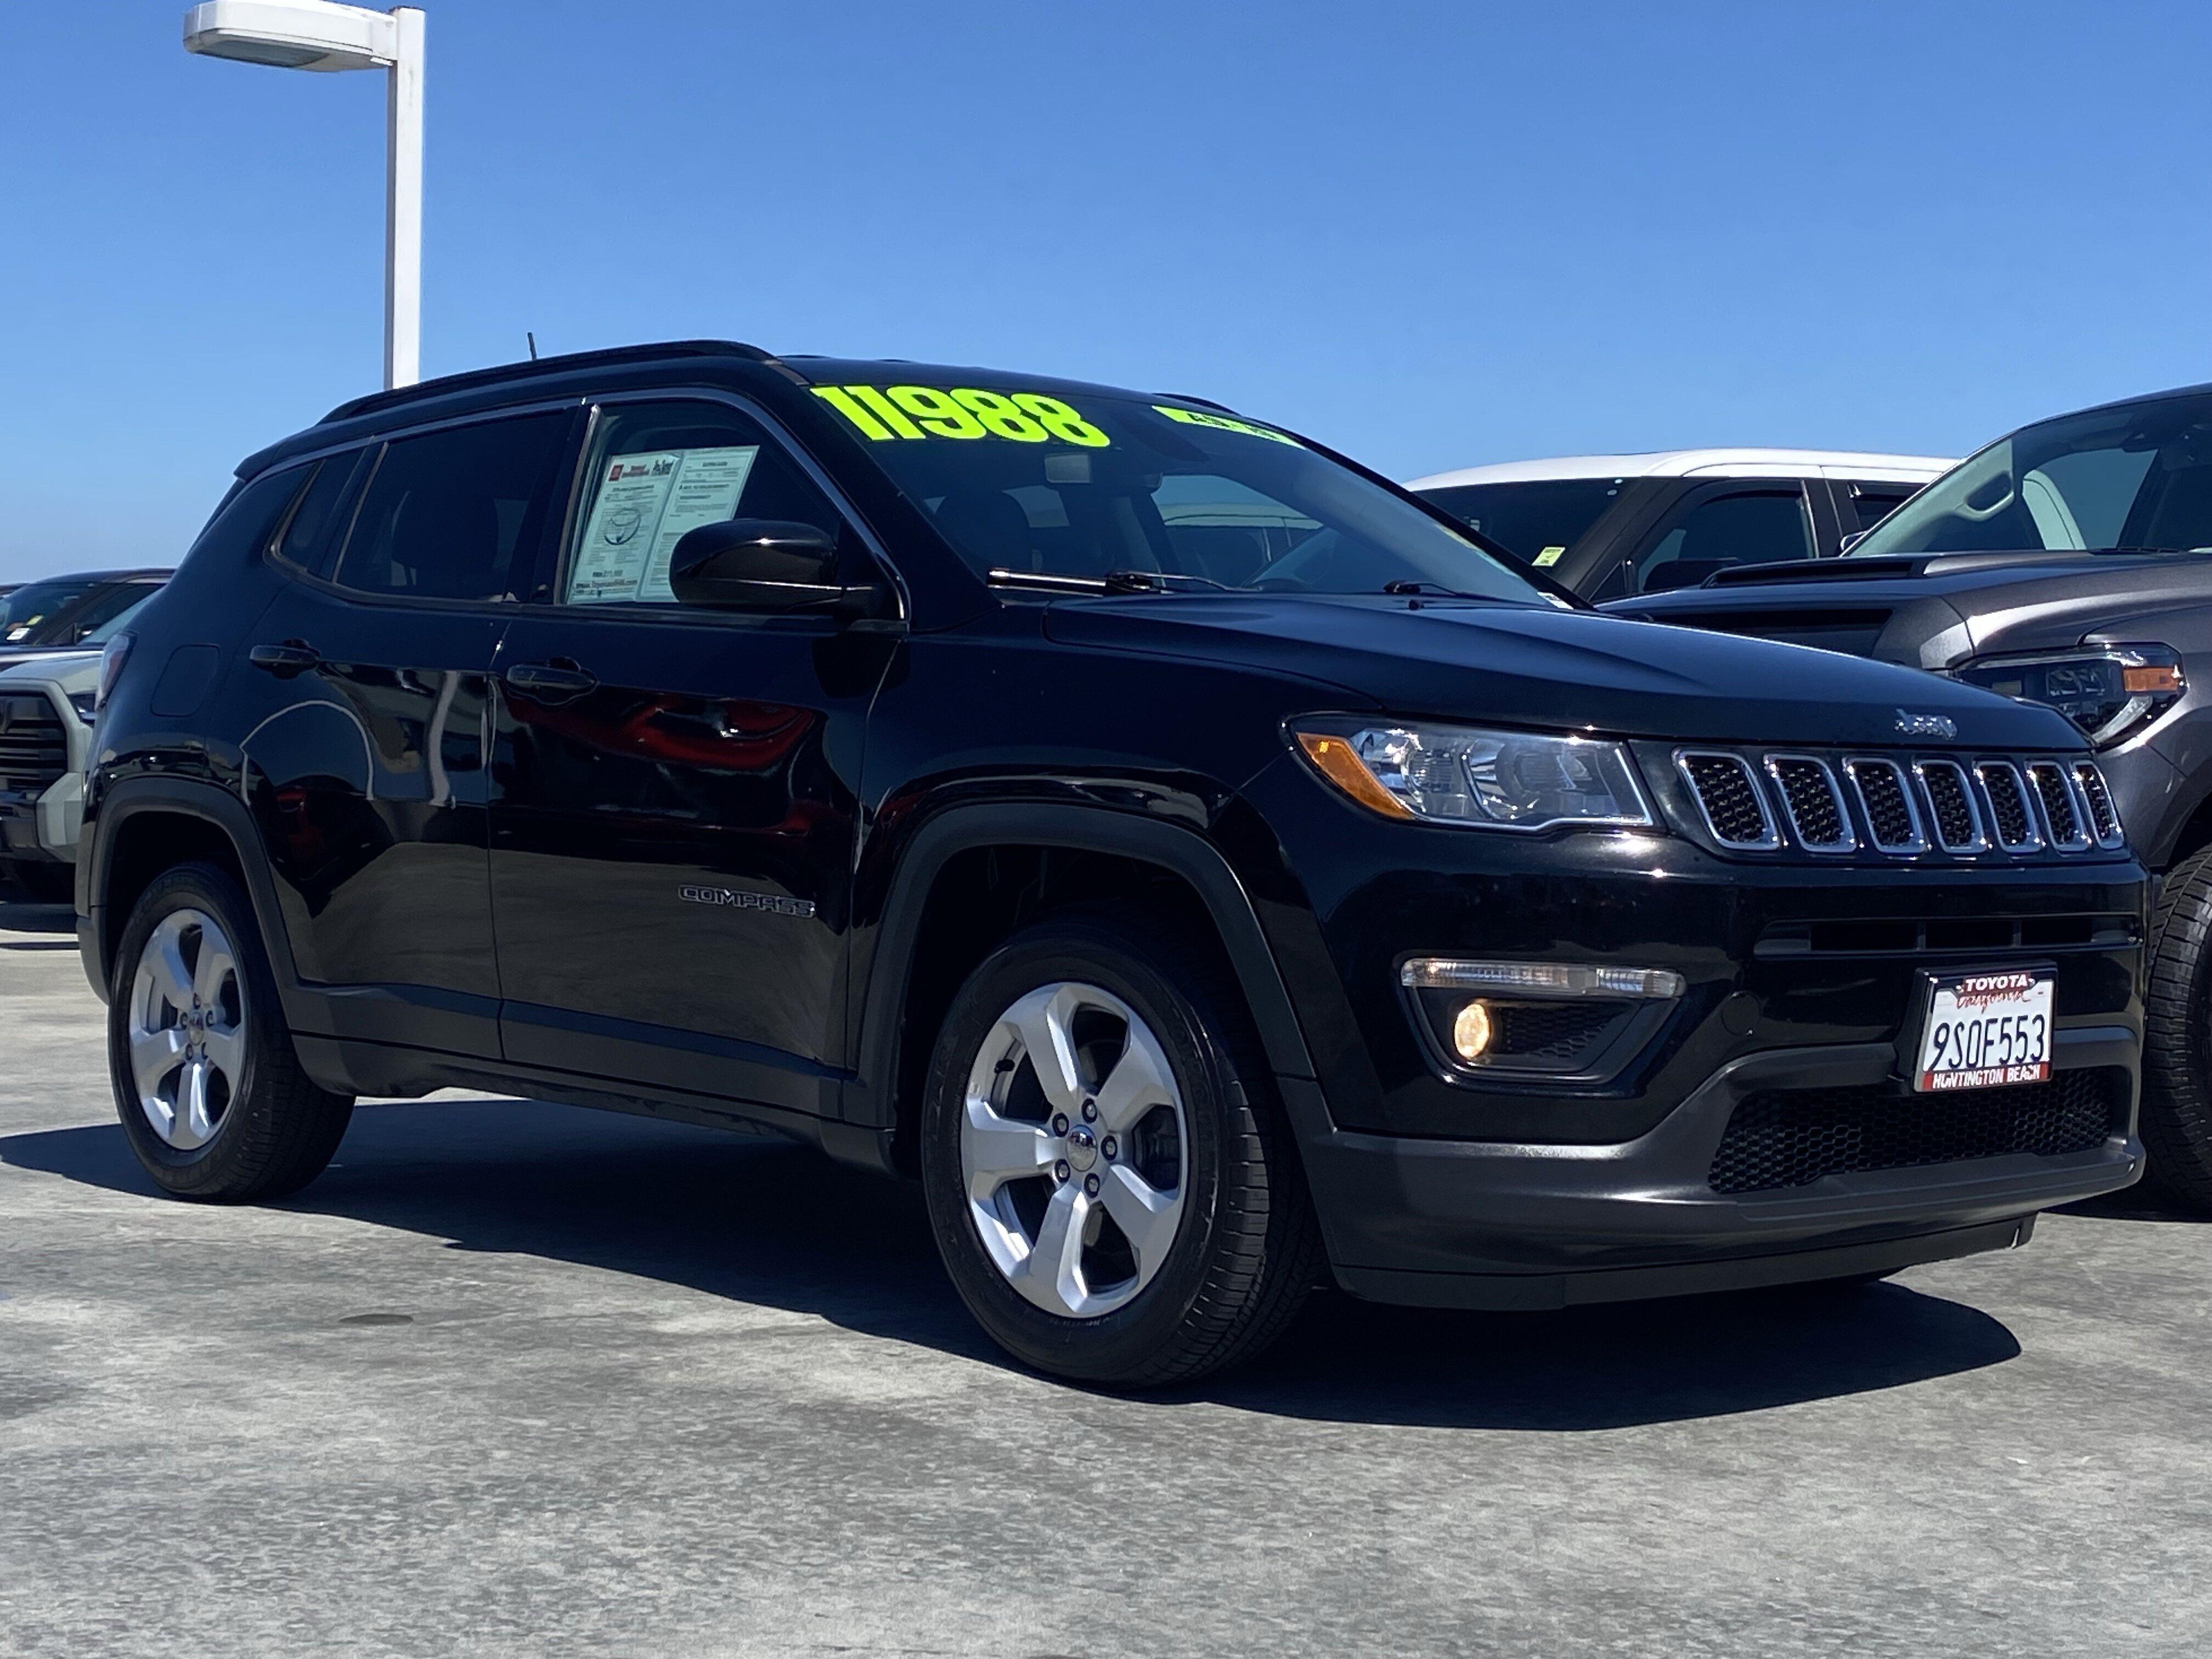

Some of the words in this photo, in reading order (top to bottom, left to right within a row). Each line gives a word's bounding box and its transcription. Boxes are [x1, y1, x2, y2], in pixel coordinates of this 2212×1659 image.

[810, 386, 1110, 447] 11988
[678, 884, 815, 918] COMPASS
[1966, 975, 2027, 991] TOYOTA
[1929, 1014, 2045, 1070] 9SOF553
[1932, 1069, 2004, 1089] HUNTINGTON
[2007, 1065, 2040, 1082] BEACH
